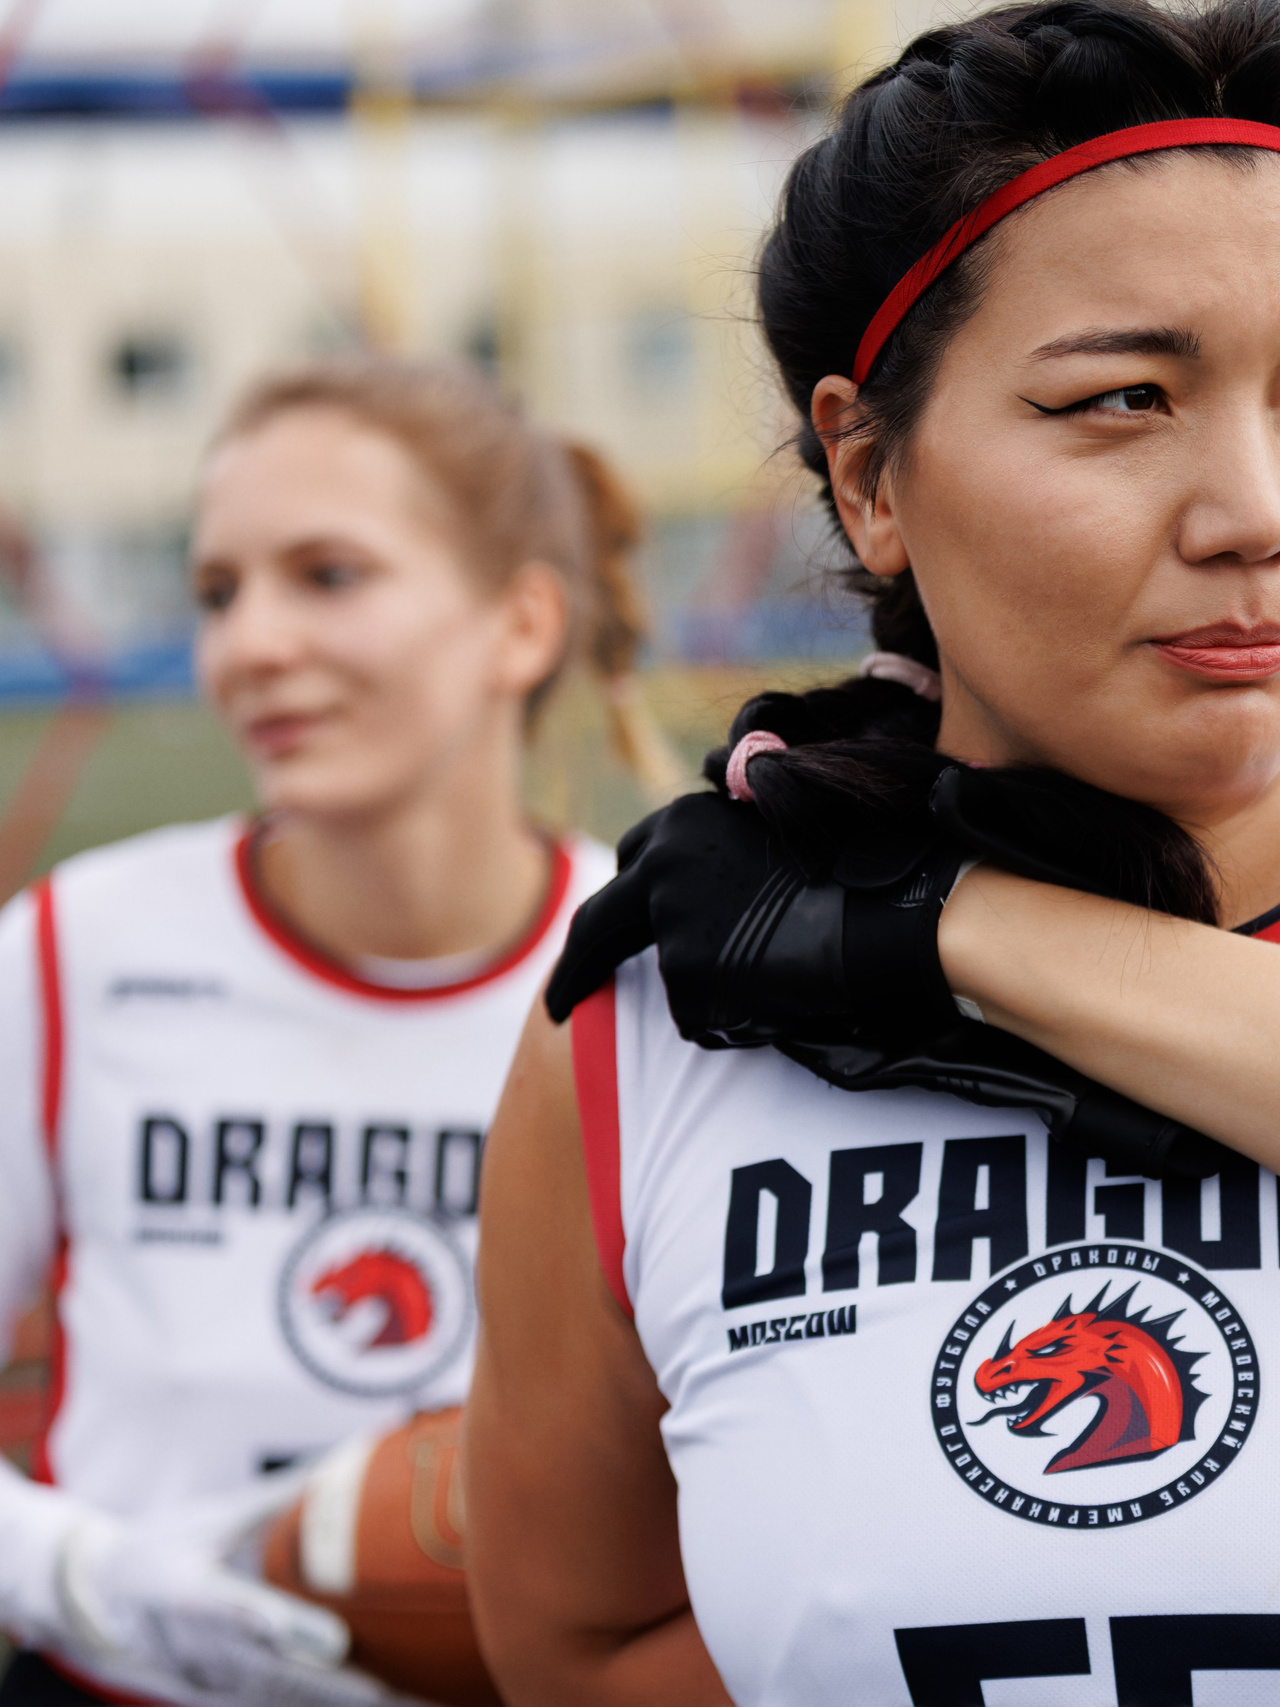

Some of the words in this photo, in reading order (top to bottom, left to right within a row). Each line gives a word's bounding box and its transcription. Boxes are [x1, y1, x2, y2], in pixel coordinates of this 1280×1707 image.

[1033, 1248, 1160, 1278] ДРАКОНЫ
[728, 1304, 857, 1353] MOSCOW
[935, 1300, 993, 1408] ФУТБОЛА
[1201, 1290, 1255, 1450] МОСКОВСКИЙ
[940, 1424, 1143, 1525] АМЕРИКАНСКОГО
[1159, 1457, 1221, 1507] КЛУБ
